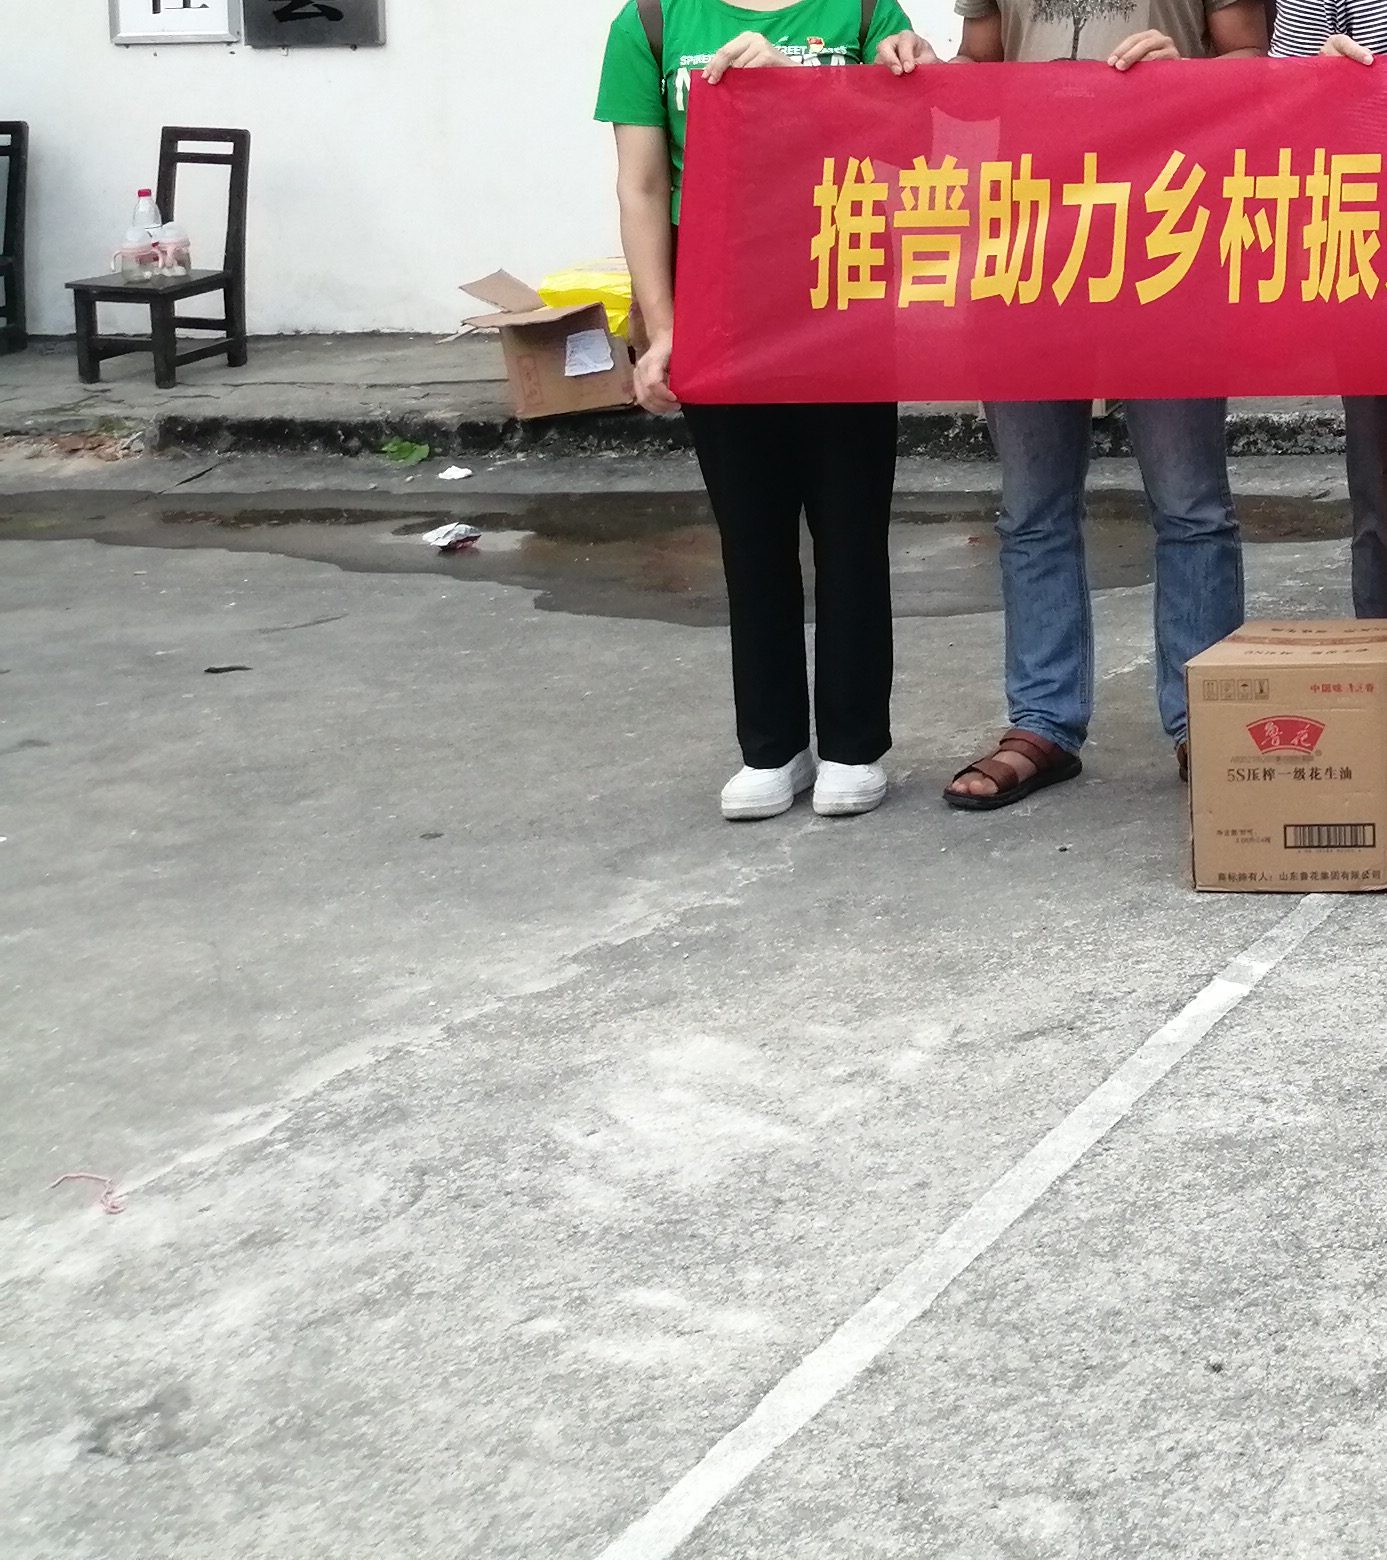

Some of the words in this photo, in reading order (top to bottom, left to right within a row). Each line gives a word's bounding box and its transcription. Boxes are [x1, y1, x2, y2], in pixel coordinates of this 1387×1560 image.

[1261, 720, 1311, 747] 鲁花
[1227, 766, 1353, 783] 5S压榨一级花生油
